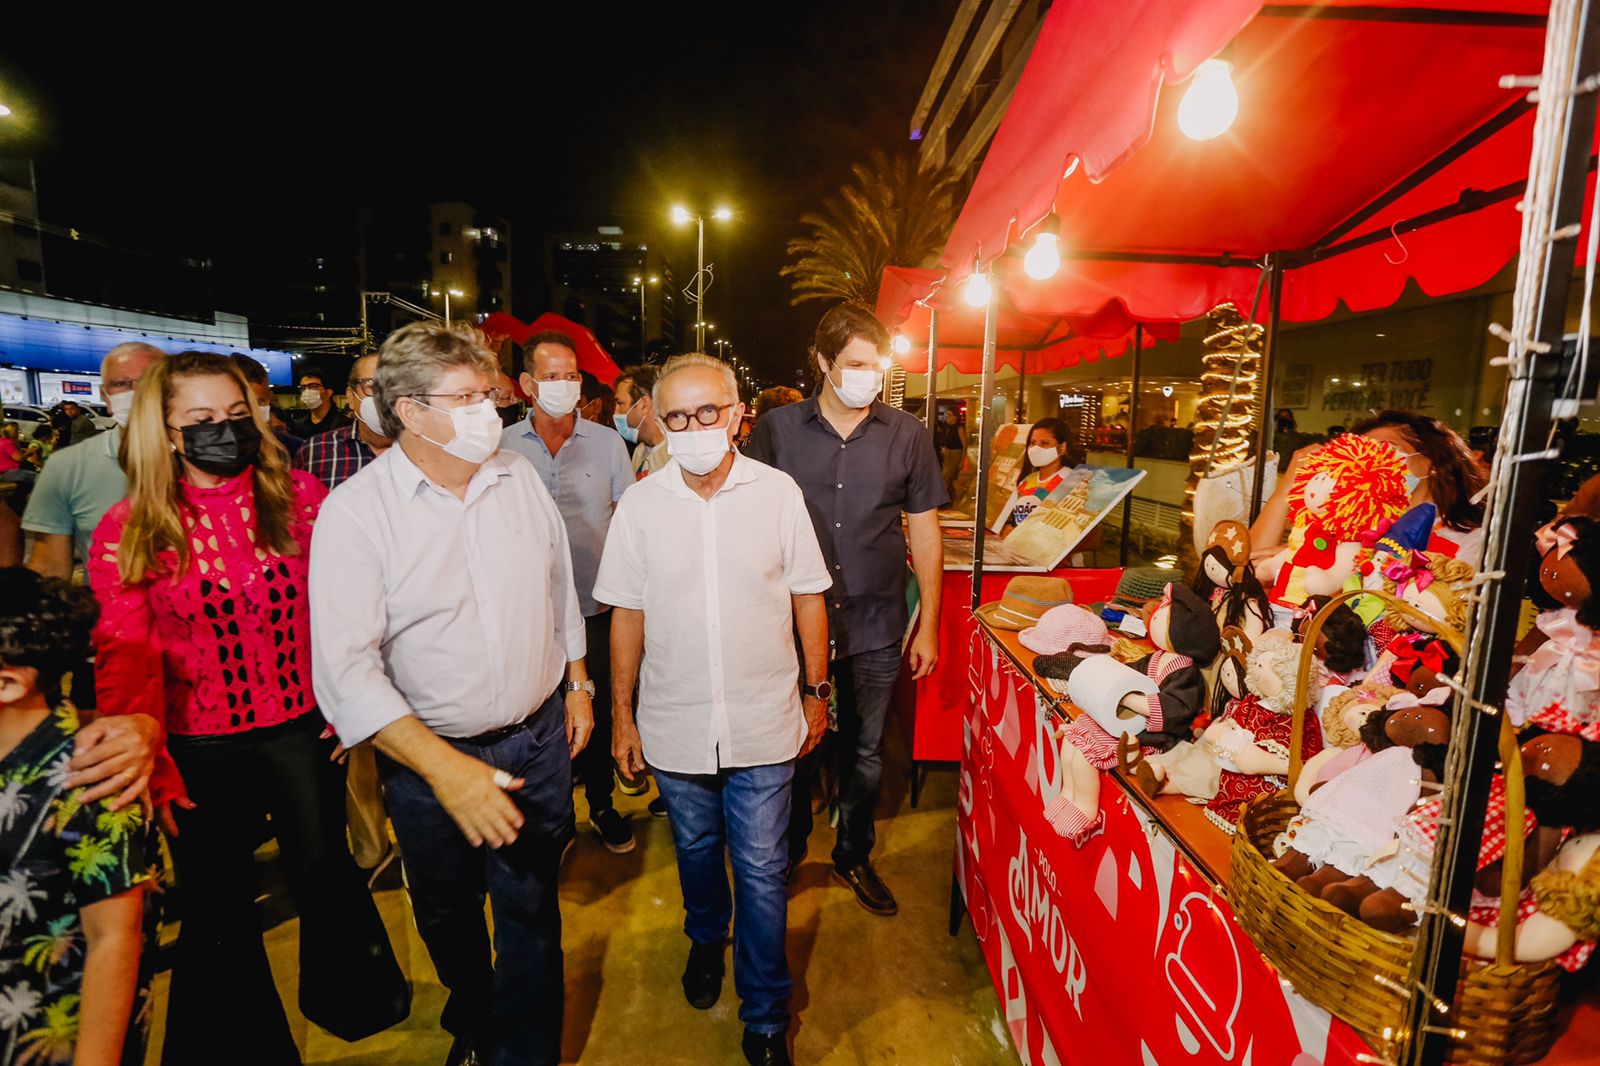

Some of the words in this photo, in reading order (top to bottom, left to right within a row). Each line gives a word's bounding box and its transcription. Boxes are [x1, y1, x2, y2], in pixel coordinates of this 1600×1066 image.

[1391, 358, 1433, 382] TUDO
[1322, 391, 1363, 411] PERTO
[1367, 389, 1386, 410] DE
[1389, 383, 1430, 409] VOCÊ
[1038, 848, 1057, 892] POLO
[1008, 825, 1087, 1022] AMOR
